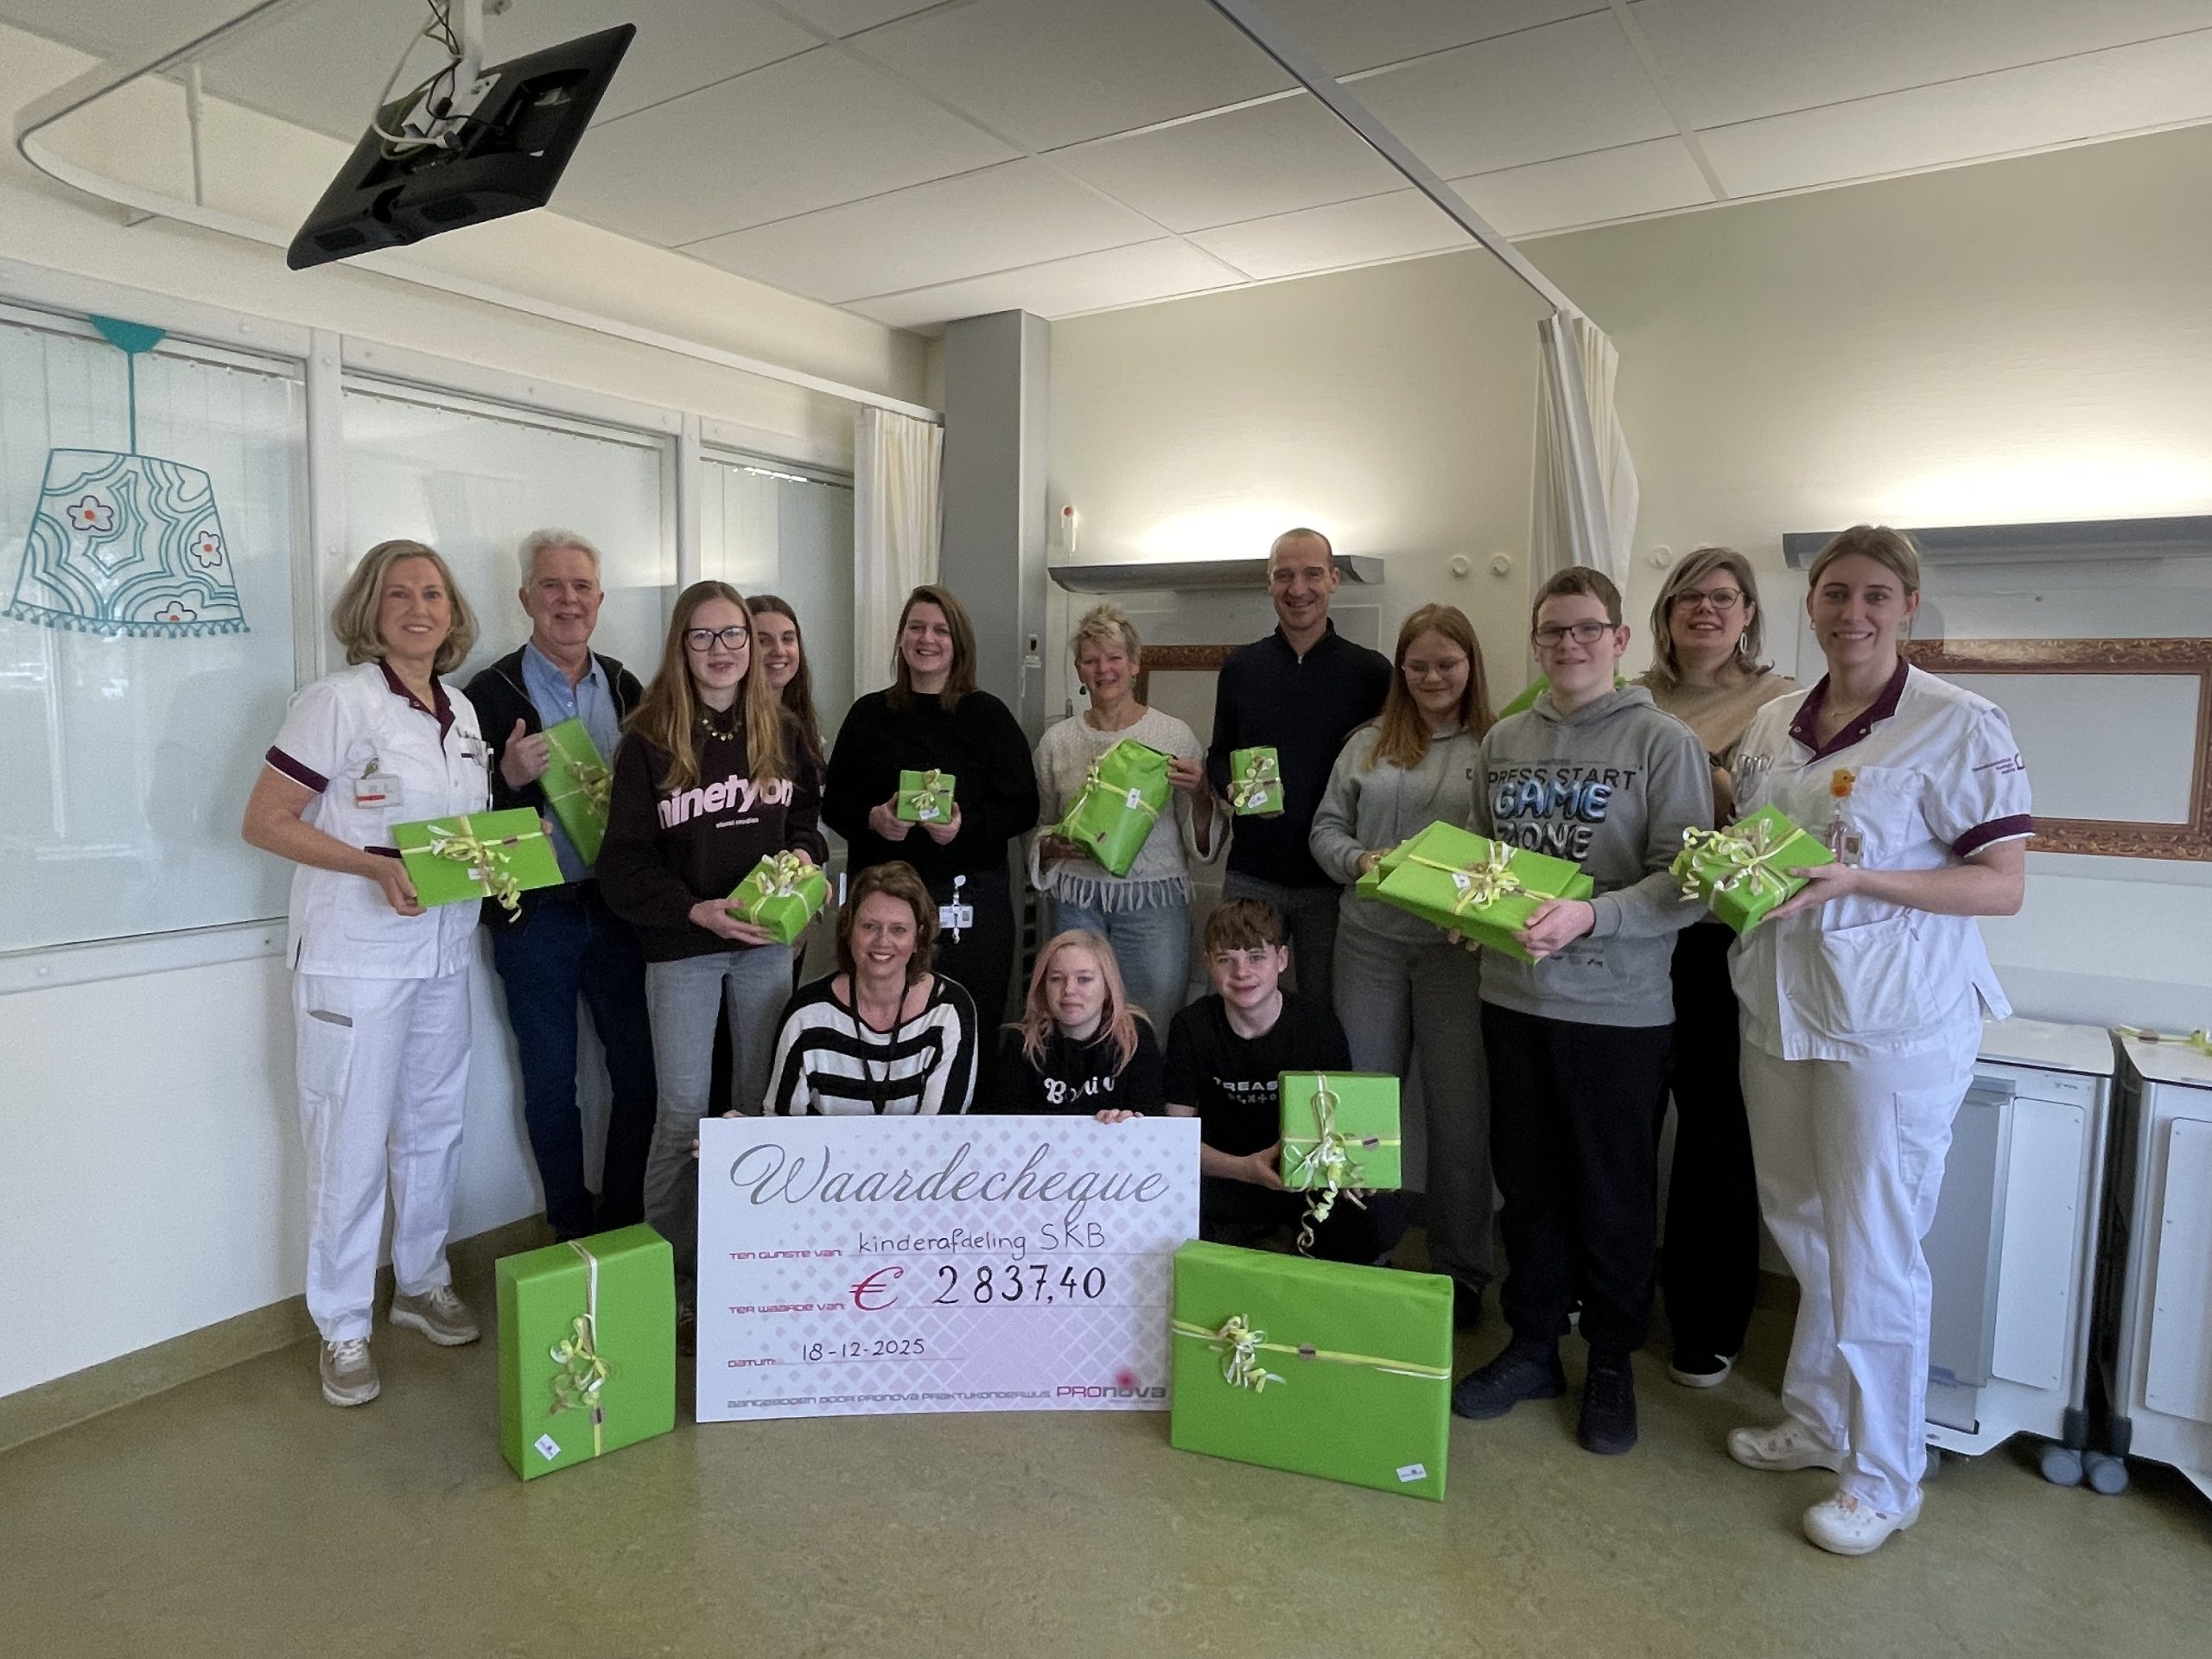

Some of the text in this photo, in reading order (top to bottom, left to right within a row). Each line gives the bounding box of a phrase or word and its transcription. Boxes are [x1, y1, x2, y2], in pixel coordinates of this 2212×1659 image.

[1487, 767, 1637, 790] PRESS START
[1493, 779, 1612, 823] GAME
[729, 1141, 1170, 1225] Waardecheque
[858, 1222, 1105, 1261] kinderafdeling SKB
[802, 1338, 925, 1362] 18-12-2025
